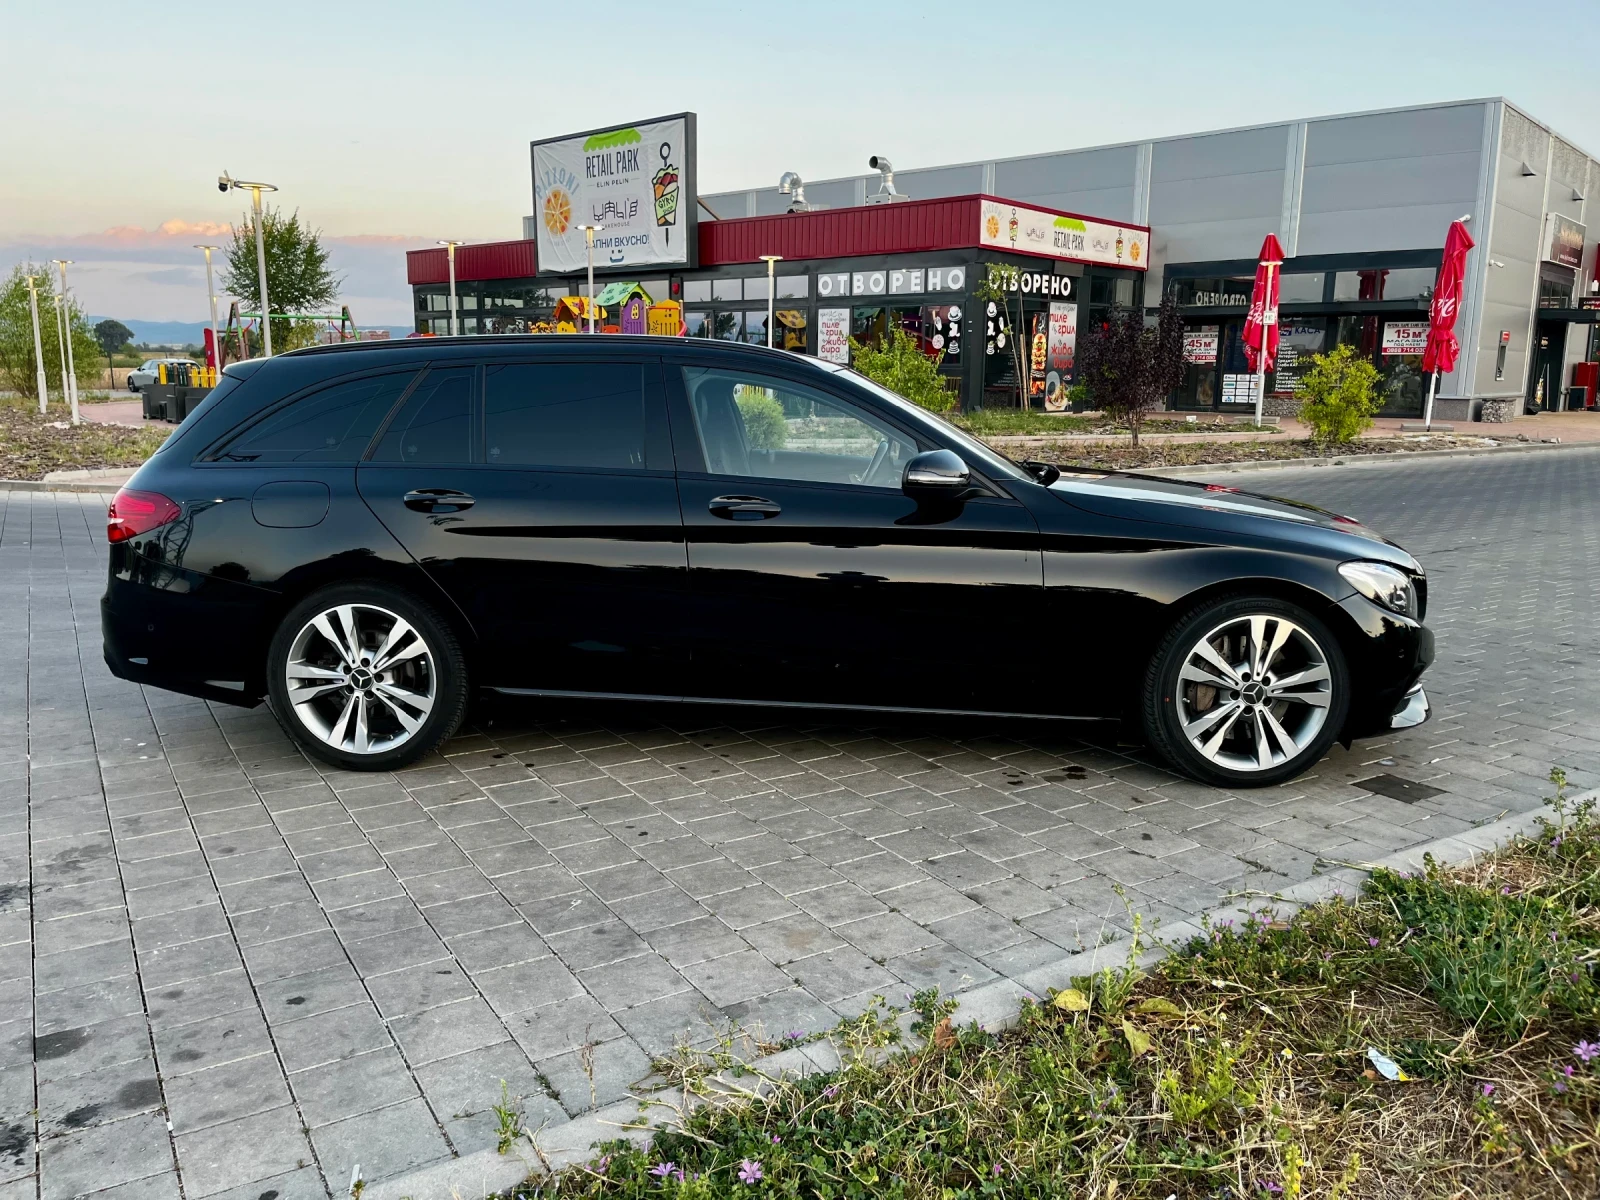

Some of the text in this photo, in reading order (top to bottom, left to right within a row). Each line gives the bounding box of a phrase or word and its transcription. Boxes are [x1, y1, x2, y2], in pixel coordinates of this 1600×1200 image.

[586, 148, 639, 178] RETAIL PARK
[611, 178, 629, 186] PELIN
[658, 194, 675, 209] GYRO
[585, 237, 613, 250] АПНИ
[614, 234, 650, 248] ВКУСНО!
[1053, 231, 1085, 252] RETAIL PARK
[818, 269, 964, 295] ОТВОРЕНО
[988, 270, 1072, 297] ОТВОРЕНО
[1394, 329, 1411, 339] 15
[1188, 339, 1203, 348] 45
